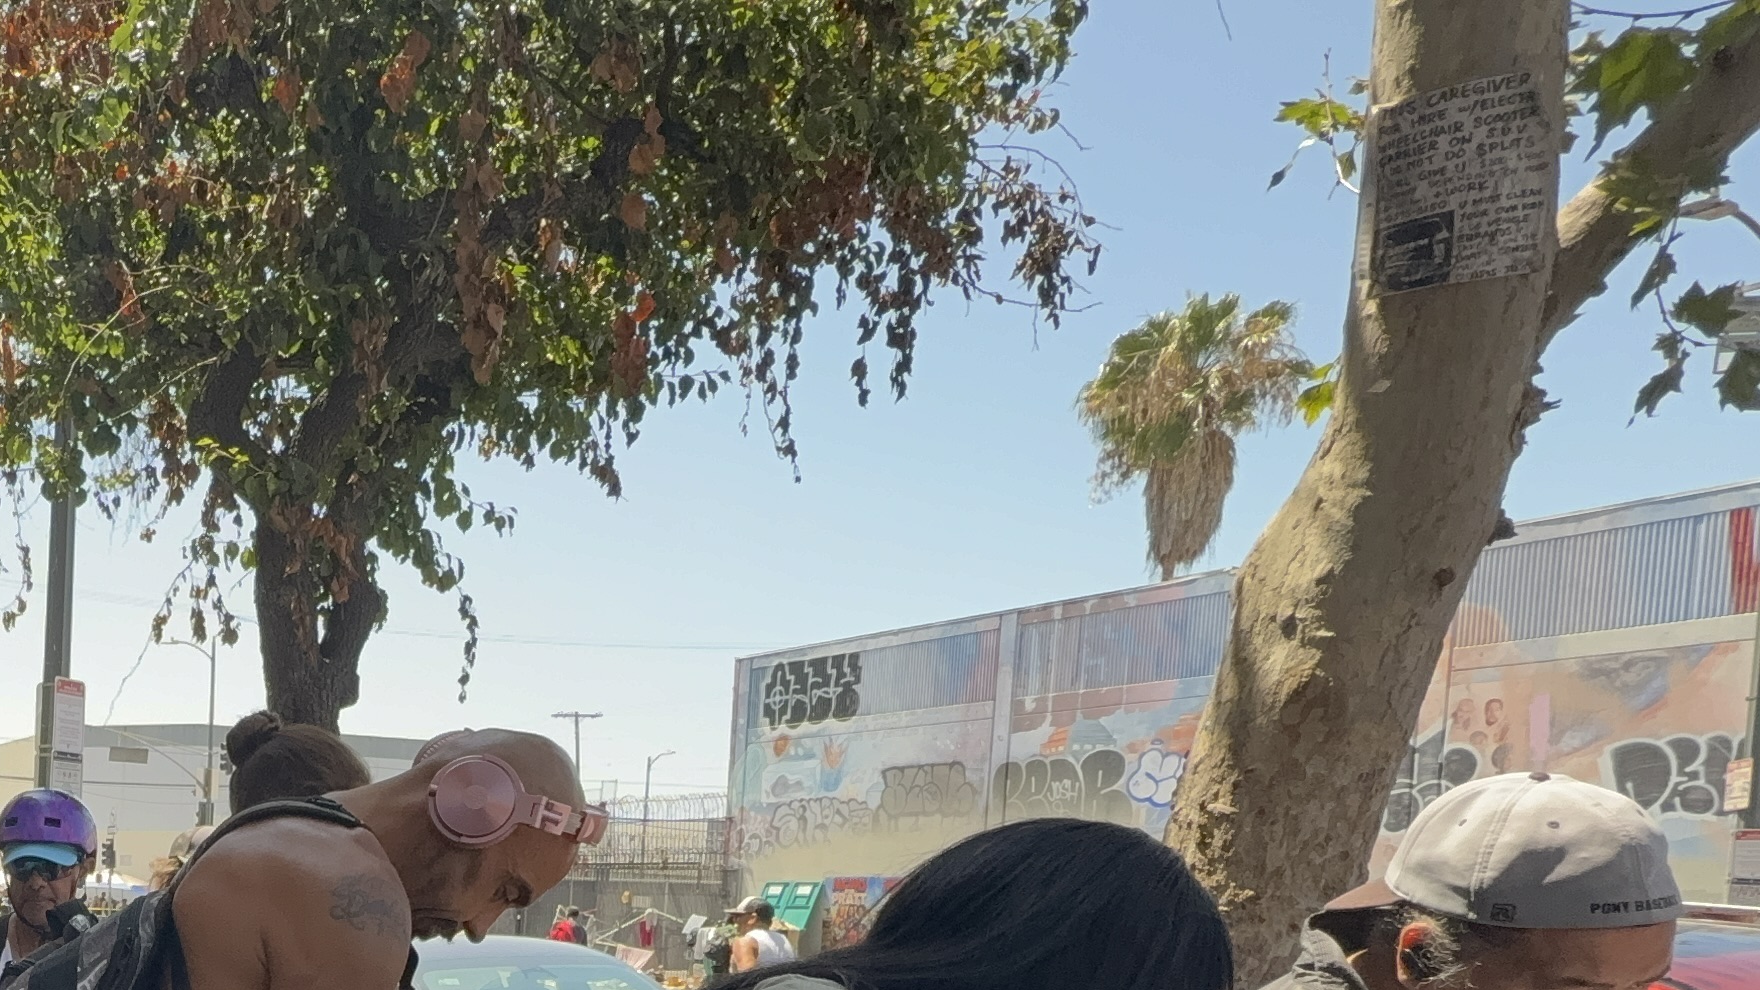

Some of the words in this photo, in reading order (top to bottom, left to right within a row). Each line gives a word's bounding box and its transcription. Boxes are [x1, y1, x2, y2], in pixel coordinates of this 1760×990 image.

[1426, 72, 1531, 107] CAREGIVER
[1378, 121, 1464, 153] WHEELCHAIR
[1474, 105, 1540, 129] SCOOTER
[1379, 140, 1439, 168] CARRIER
[1448, 132, 1473, 148] ON
[1406, 154, 1436, 170] NOT
[1444, 148, 1467, 161] DO
[1454, 160, 1466, 174] U
[1446, 180, 1489, 197] WORK
[1459, 200, 1468, 210] U
